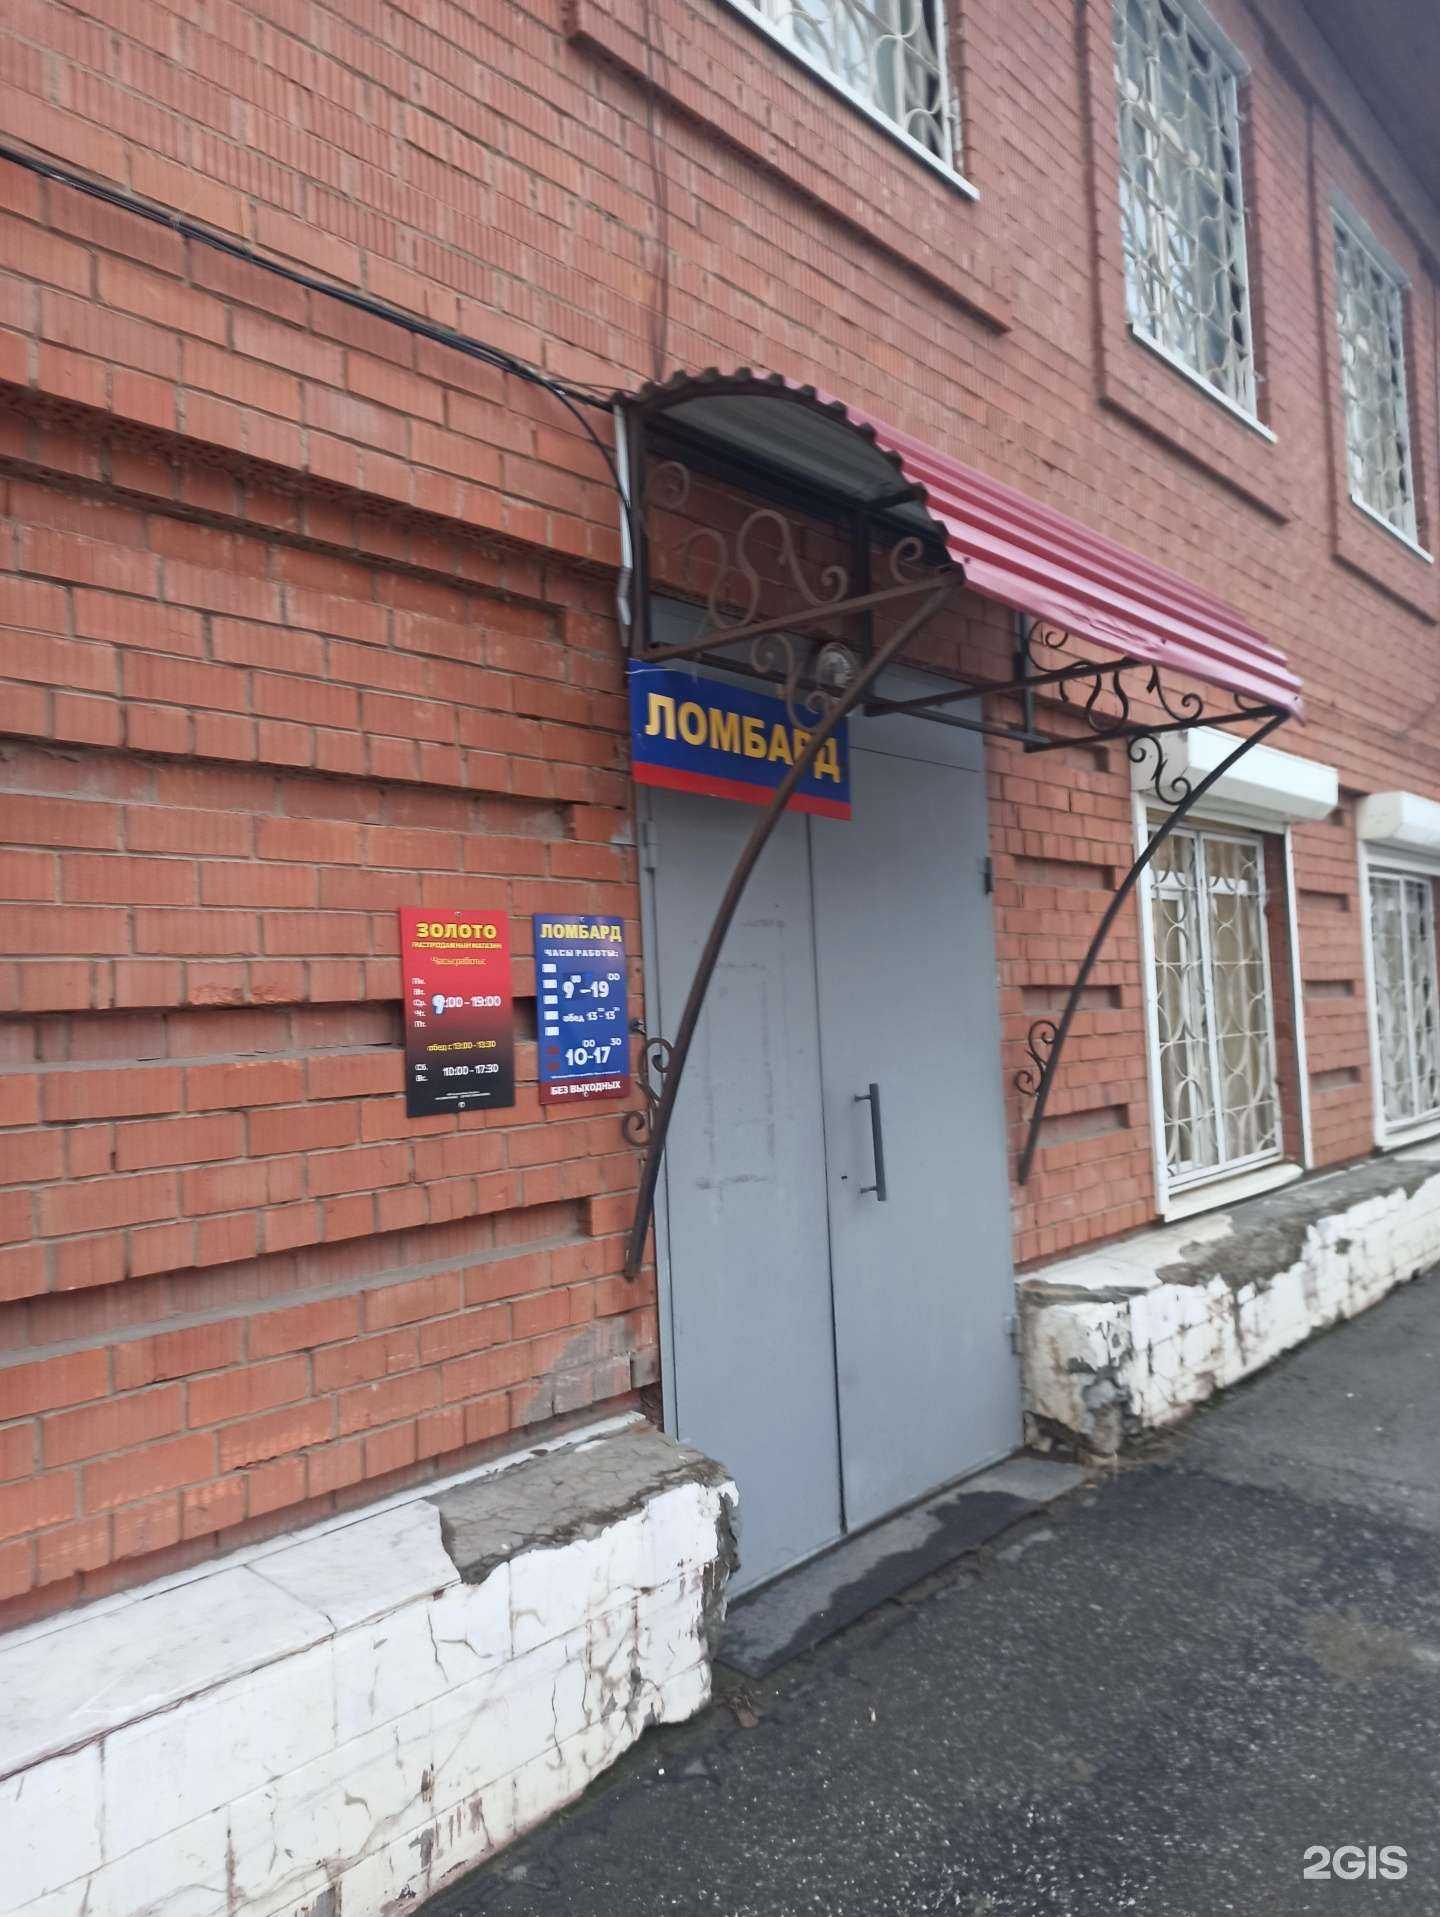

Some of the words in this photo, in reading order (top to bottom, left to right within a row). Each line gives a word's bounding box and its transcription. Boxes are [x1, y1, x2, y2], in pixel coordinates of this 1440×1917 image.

[416, 922, 497, 939] ЗОЛОТО
[540, 923, 622, 942] ЛОМБАРД
[544, 949, 573, 957] ЧАСЫ
[575, 949, 618, 957] РАБОТЫ:
[550, 1086, 568, 1096] БЕЗ
[569, 1080, 621, 1094] ВЫХОДНЫХ
